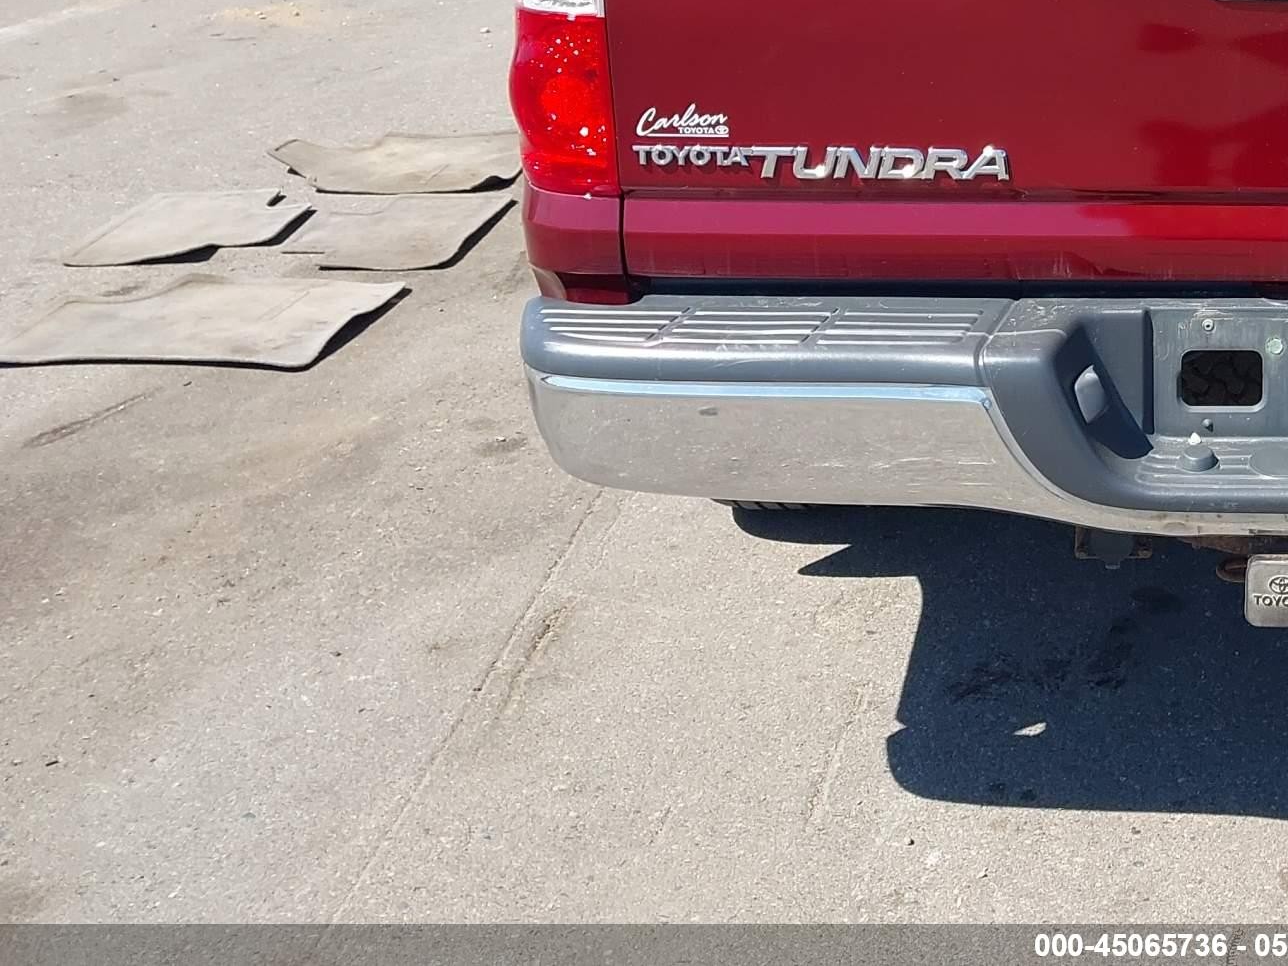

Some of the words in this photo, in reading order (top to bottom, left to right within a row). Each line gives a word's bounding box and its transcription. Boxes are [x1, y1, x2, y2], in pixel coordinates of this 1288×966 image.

[636, 103, 728, 136] Carlson
[678, 126, 715, 135] TOYOTA
[632, 144, 749, 166] TOYOTA
[750, 145, 1010, 181] TUNDRA
